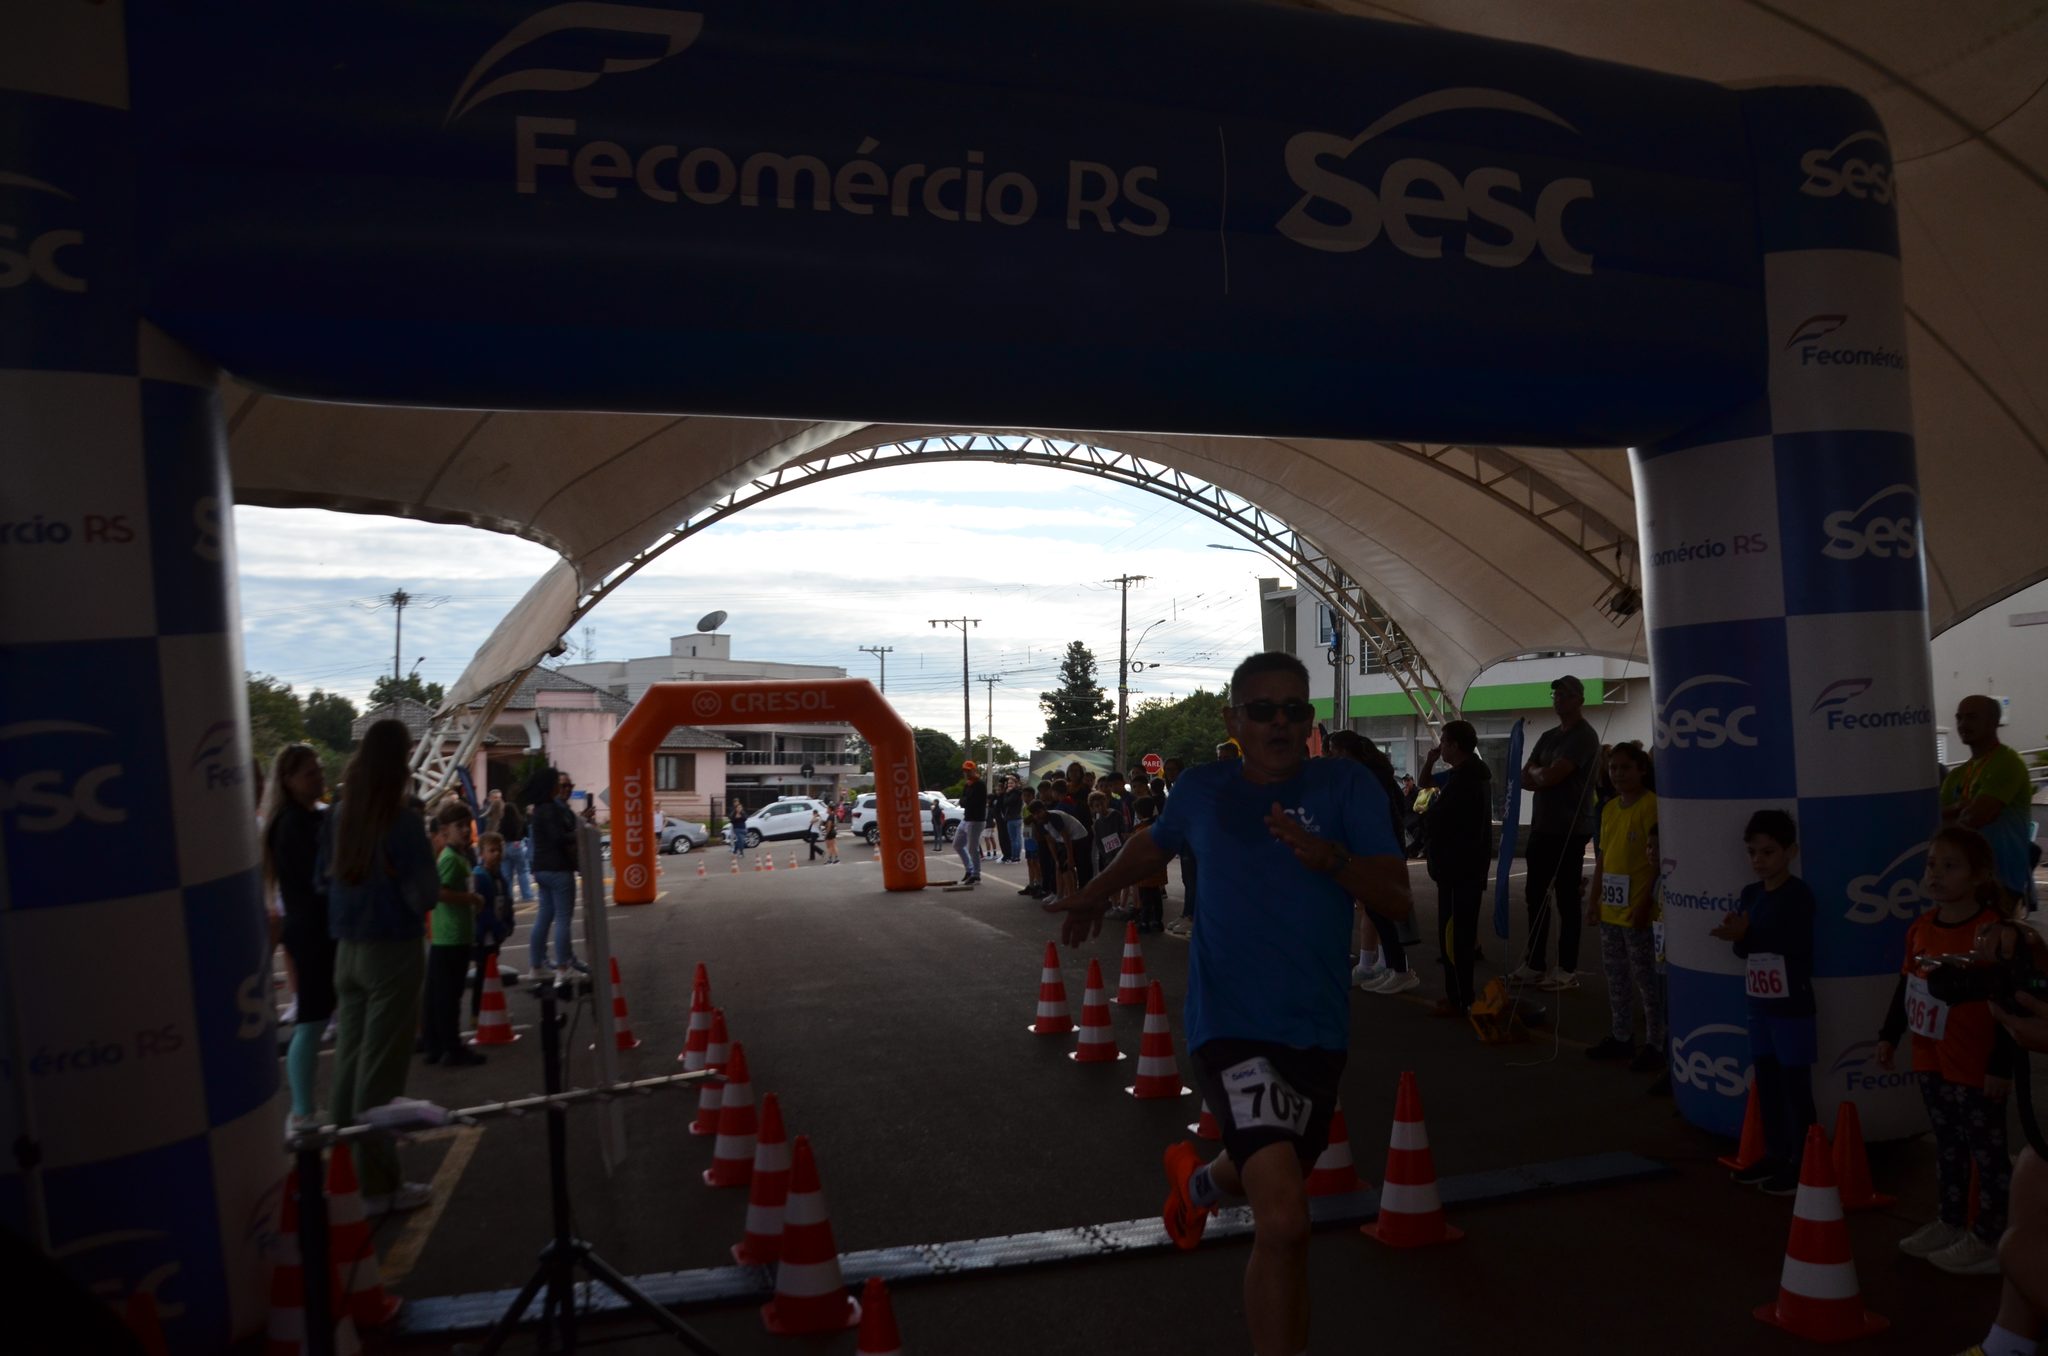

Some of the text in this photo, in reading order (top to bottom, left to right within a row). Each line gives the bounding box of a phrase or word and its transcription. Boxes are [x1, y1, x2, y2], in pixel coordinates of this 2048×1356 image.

[515, 115, 1171, 237] Fecomércio RS
[1276, 128, 1595, 275] Sesc
[84, 514, 135, 544] RS
[1733, 533, 1768, 555] RS
[731, 690, 835, 713] CRESOL
[1143, 760, 1161, 768] PARE
[624, 768, 643, 858] CRESOL
[892, 756, 914, 842] CRESOL
[1241, 1082, 1305, 1123] 709
